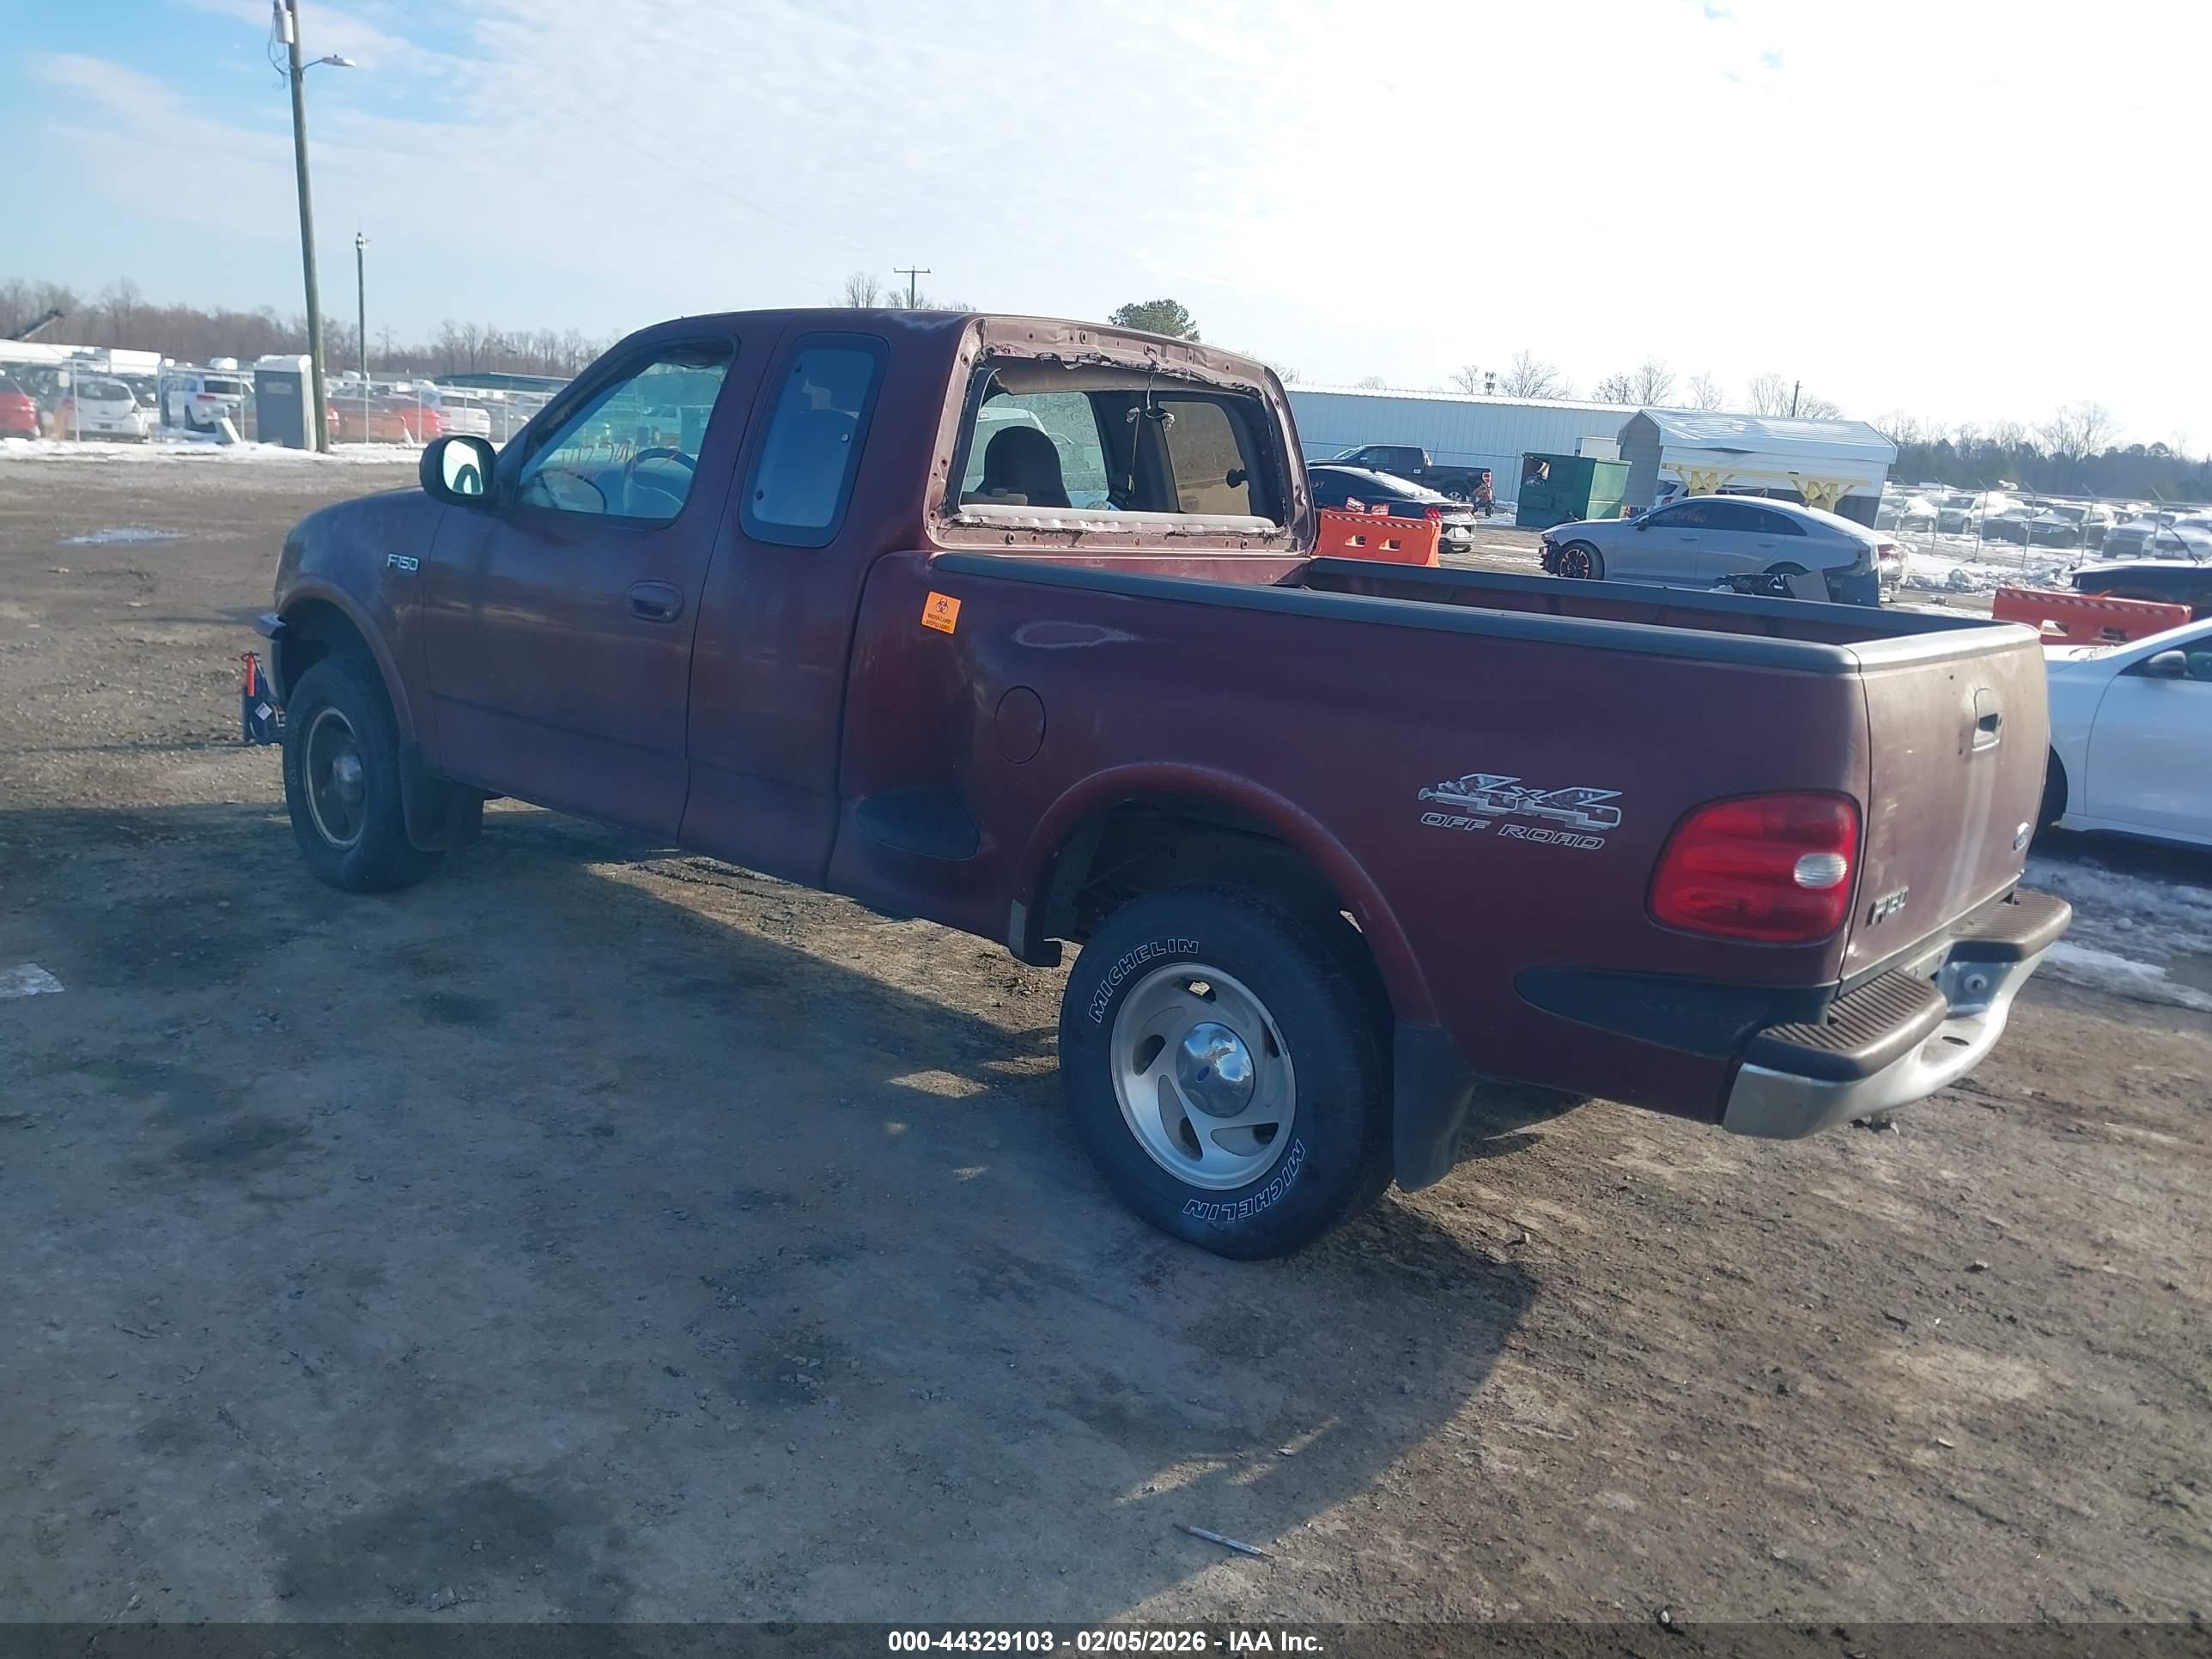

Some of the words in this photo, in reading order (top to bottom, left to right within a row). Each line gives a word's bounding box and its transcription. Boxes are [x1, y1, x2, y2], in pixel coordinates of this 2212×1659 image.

[386, 553, 419, 571] F150
[927, 613, 951, 624] BIOHAZARD
[1420, 812, 1492, 831] OFF
[1498, 823, 1607, 850] ROAD
[1088, 938, 1200, 1024] MICHELIN
[1182, 1139, 1307, 1221] MICHELIN
